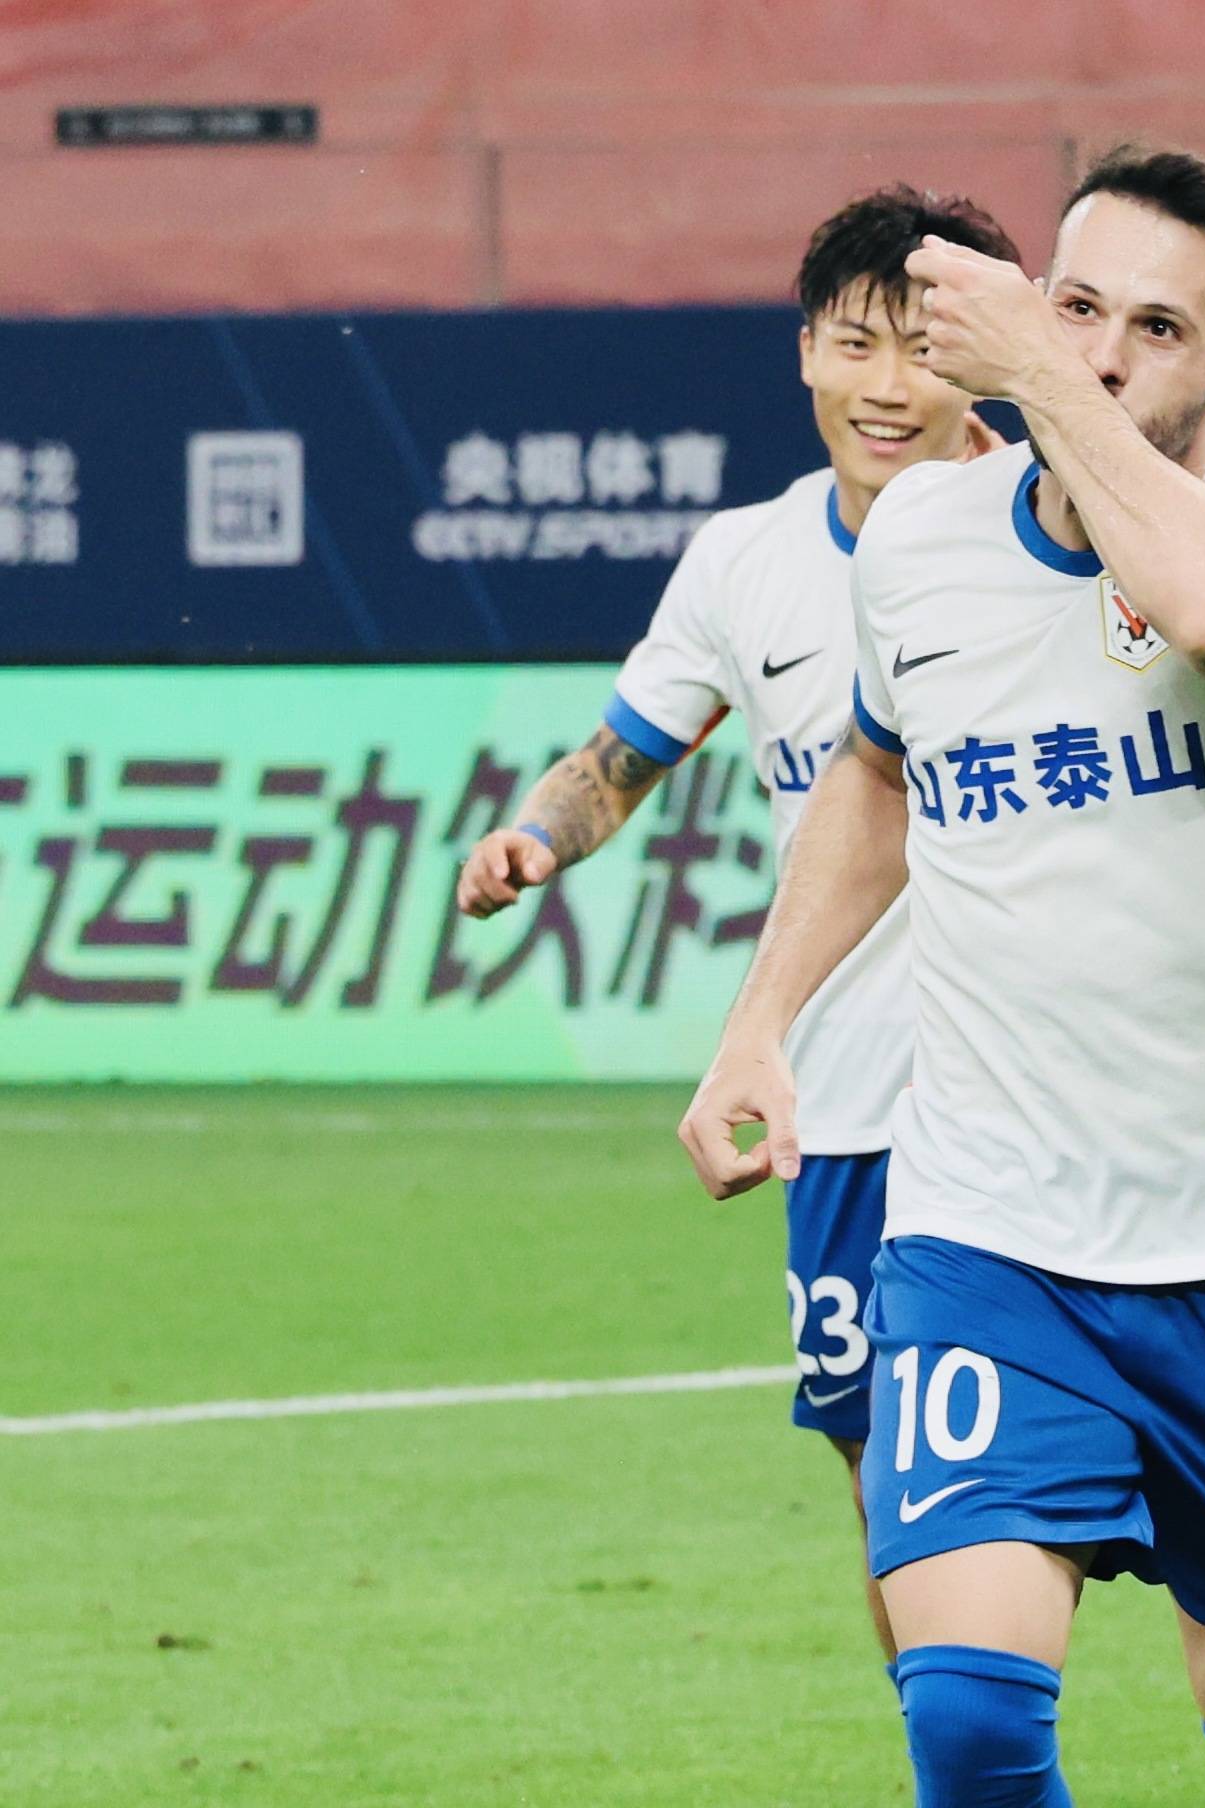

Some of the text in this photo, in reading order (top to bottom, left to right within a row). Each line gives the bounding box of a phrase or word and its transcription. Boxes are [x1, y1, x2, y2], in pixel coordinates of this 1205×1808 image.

[0, 745, 772, 1008] 运动饮料
[893, 1346, 1000, 1472] 10
